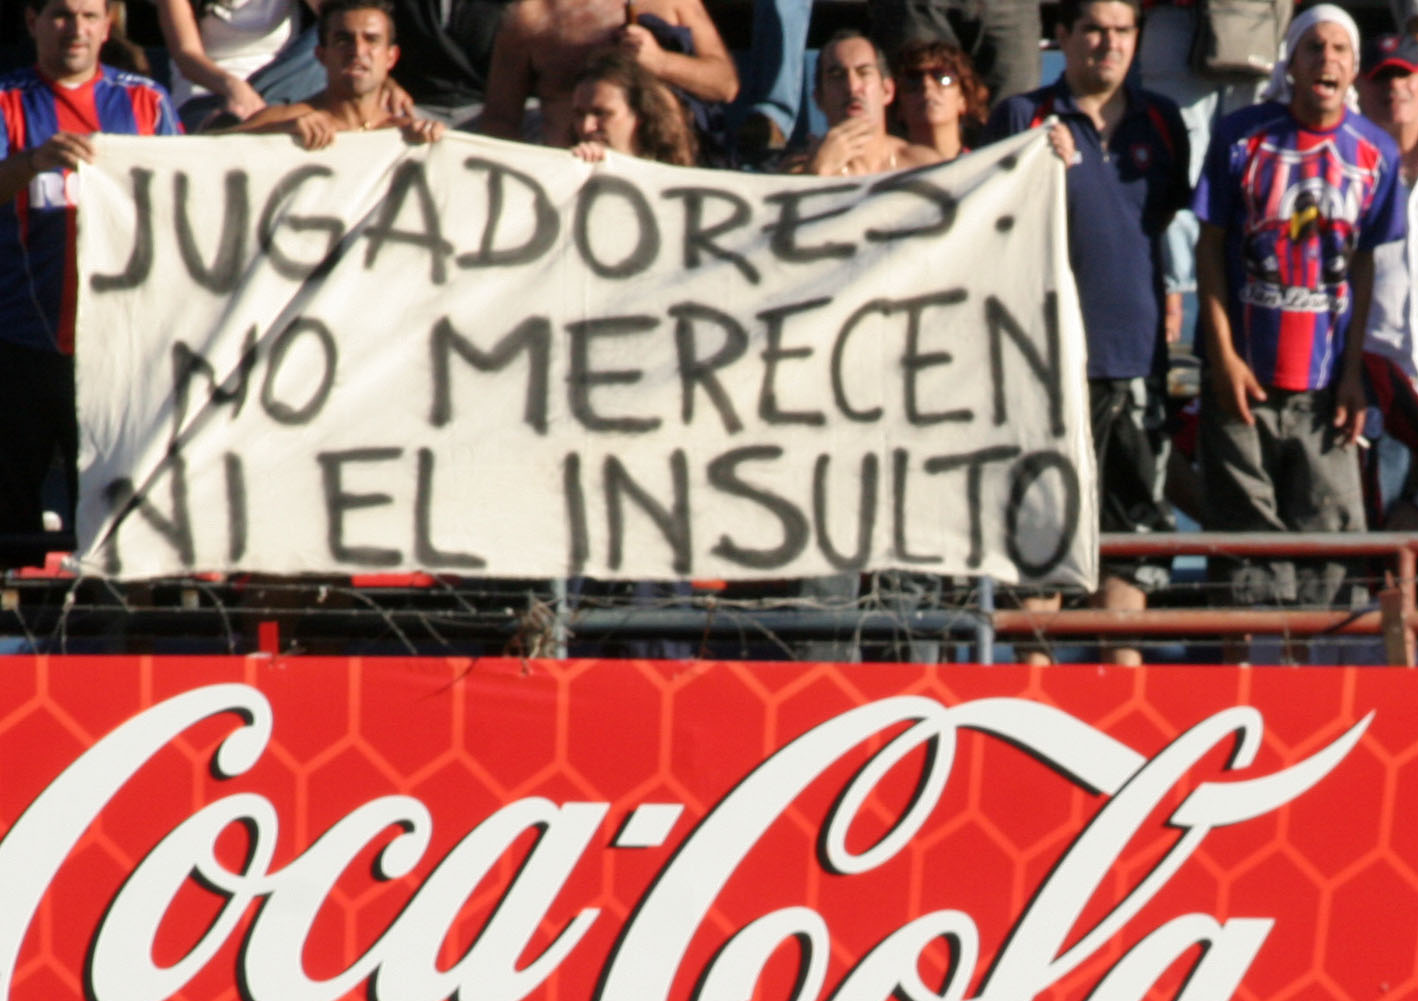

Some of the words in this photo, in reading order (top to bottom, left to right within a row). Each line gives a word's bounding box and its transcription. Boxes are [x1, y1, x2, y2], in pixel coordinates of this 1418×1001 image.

[171, 314, 339, 444] NO
[428, 286, 1066, 438] MERECEN
[105, 450, 248, 576] NI
[315, 445, 487, 567] EL
[562, 443, 1081, 577] INSULTO
